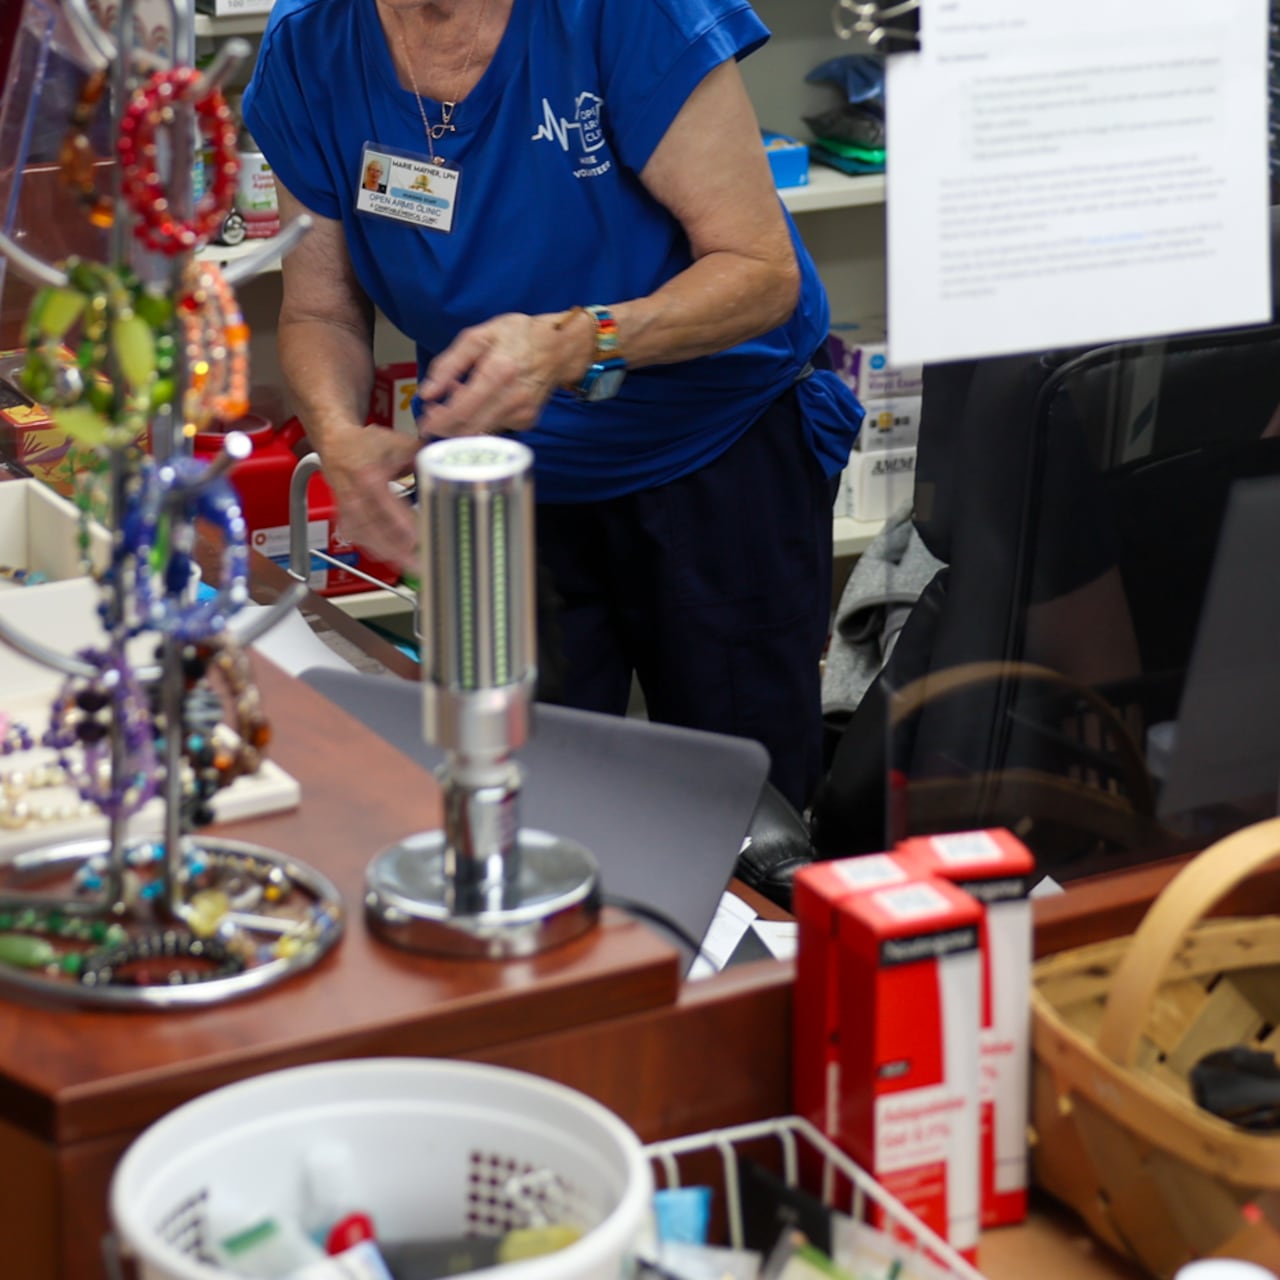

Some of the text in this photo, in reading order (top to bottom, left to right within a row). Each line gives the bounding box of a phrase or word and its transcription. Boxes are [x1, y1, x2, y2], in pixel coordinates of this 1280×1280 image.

[392, 161, 413, 171] MARIE
[369, 193, 441, 216] OPEN ARMS CLINIC
